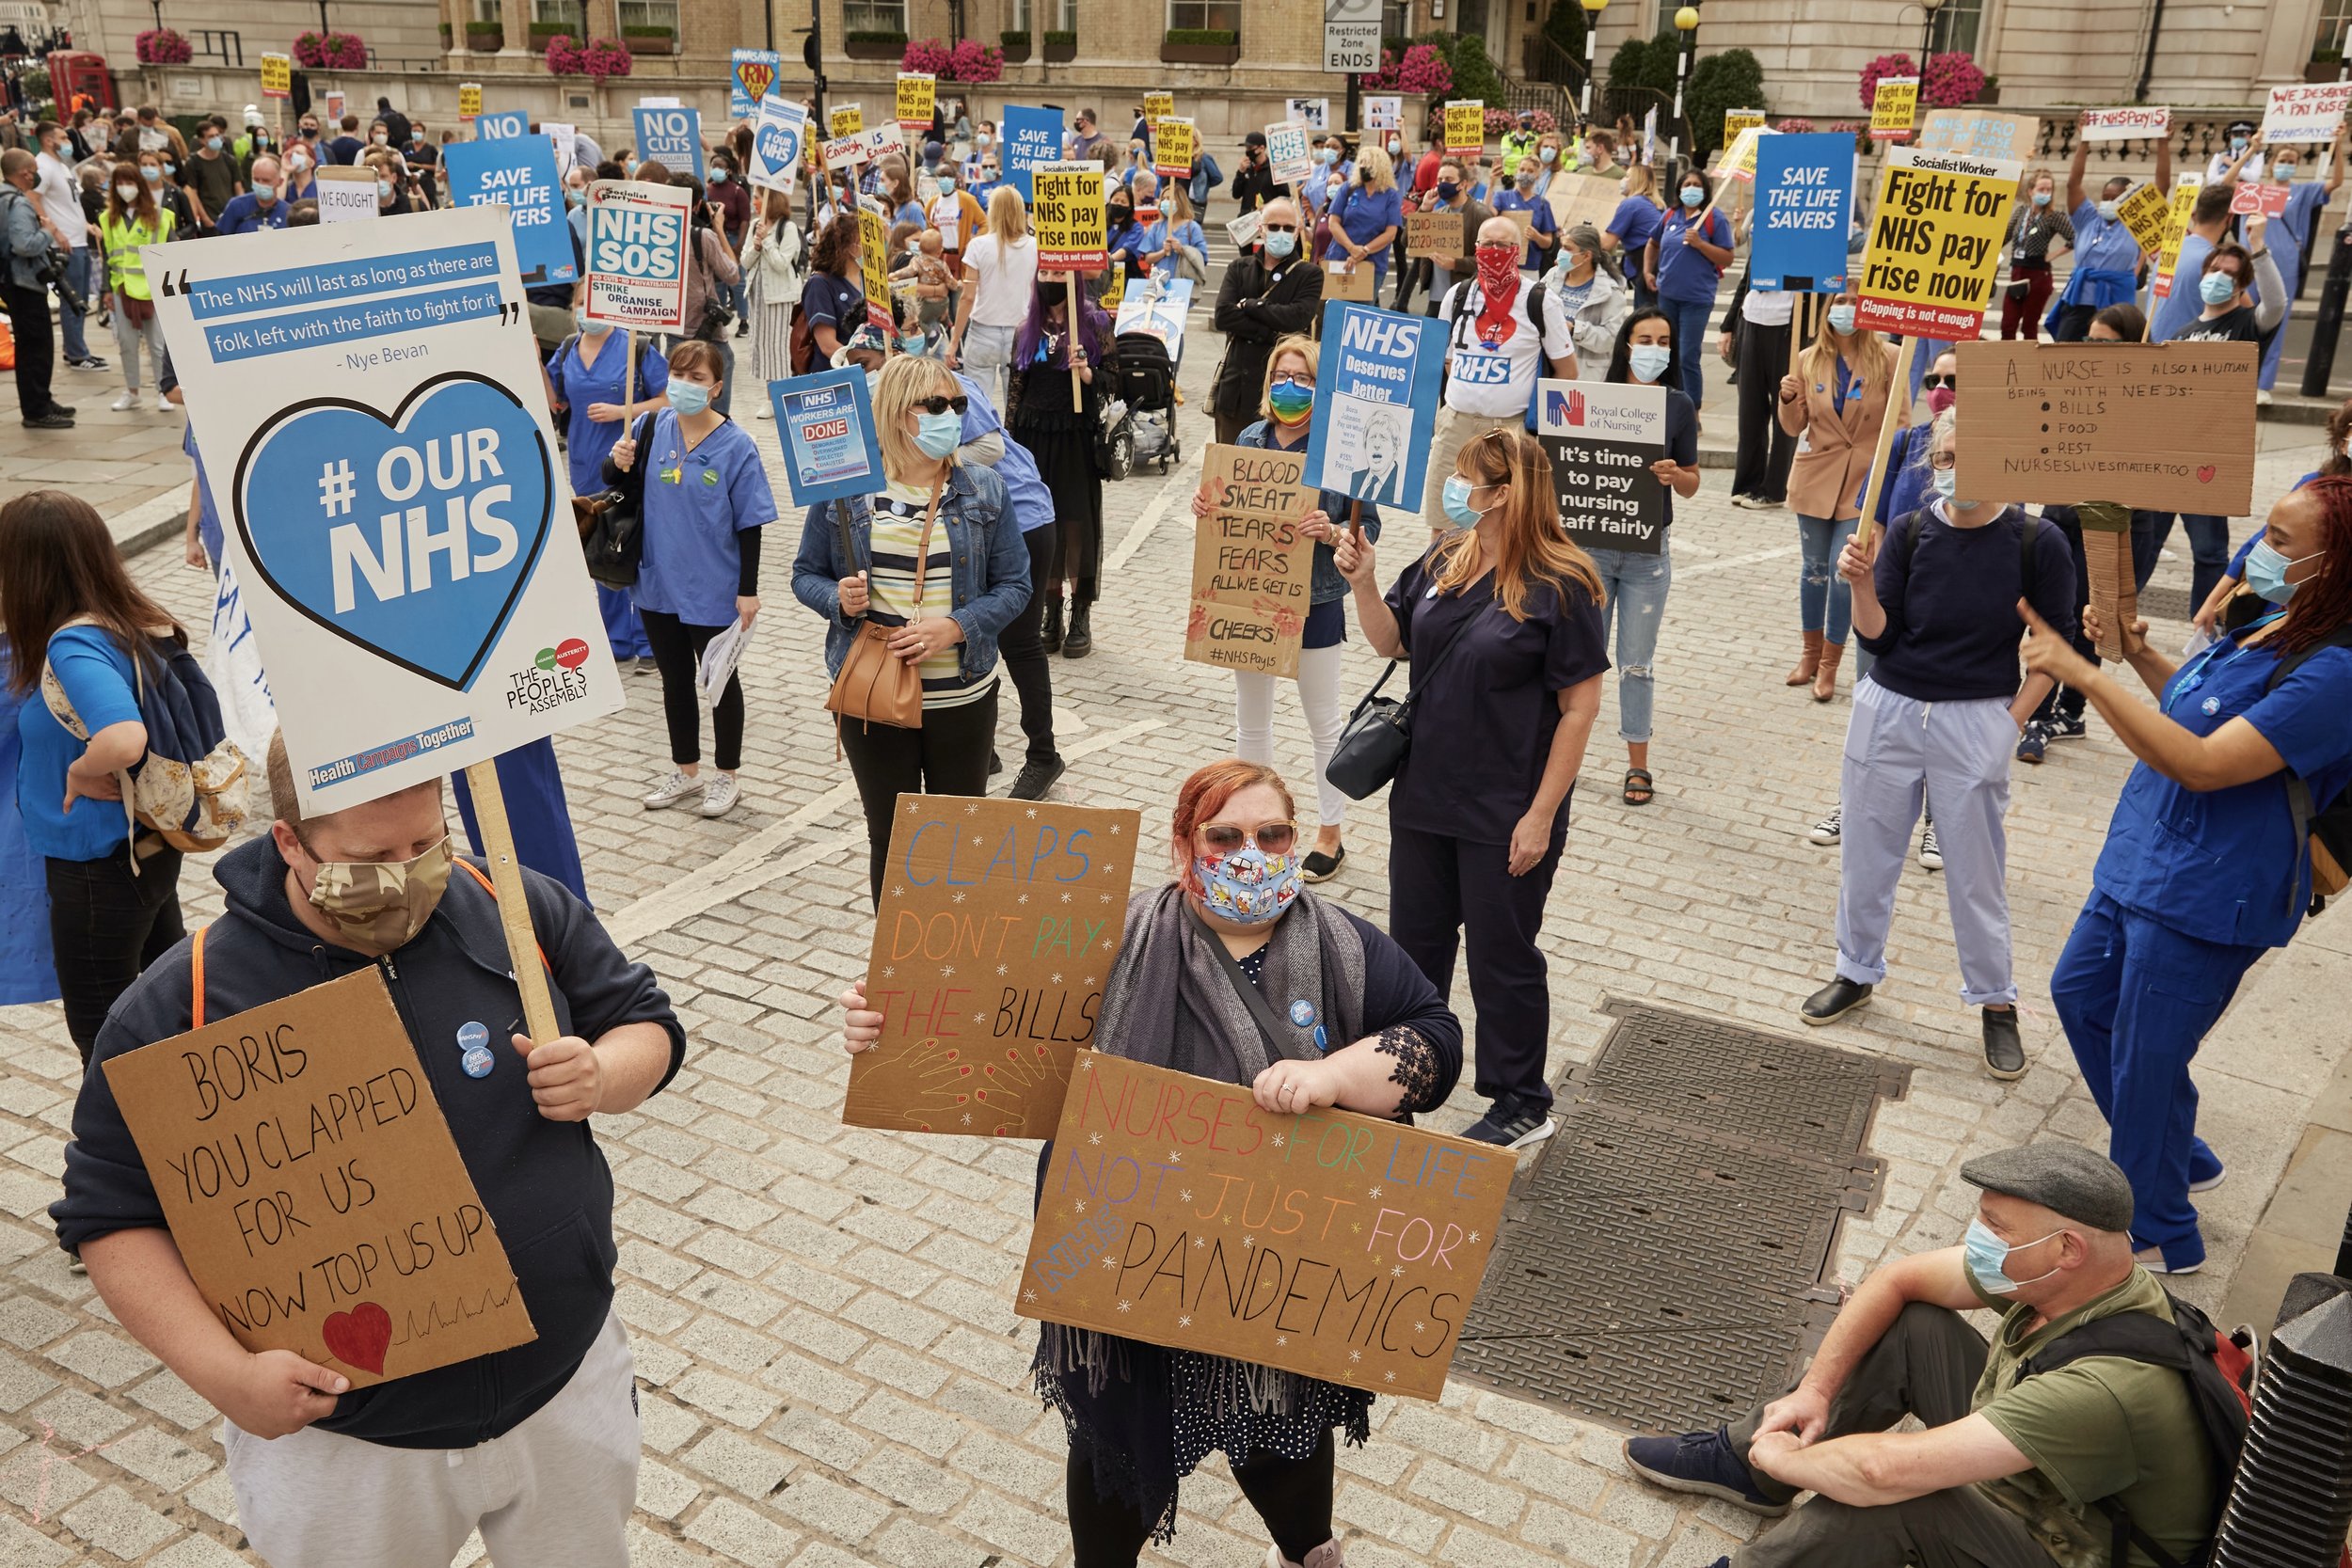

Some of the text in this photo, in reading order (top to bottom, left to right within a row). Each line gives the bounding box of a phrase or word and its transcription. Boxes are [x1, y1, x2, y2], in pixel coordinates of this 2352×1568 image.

[1328, 25, 1377, 36] Restricted
[1341, 39, 1363, 48] Zone
[1331, 54, 1373, 67] ENDS
[899, 80, 932, 93] Fight for
[1878, 86, 1915, 100] Fight for
[898, 94, 930, 107] NHS pay
[1875, 101, 1911, 115] NHS pay
[833, 114, 848, 127] Fight
[898, 105, 914, 117] rise
[1448, 107, 1480, 121] Fight for
[482, 116, 521, 140] NO
[643, 113, 689, 136] NO
[1158, 123, 1190, 137] Fight for
[1448, 121, 1479, 134] NHS pay
[647, 137, 691, 151] CUTS
[772, 135, 792, 147] OUR
[1019, 129, 1049, 144] SAVE
[1158, 139, 1188, 153] NHS pay
[1269, 132, 1302, 150] NHS
[1448, 134, 1462, 144] rise
[1010, 143, 1057, 159] THE LIFE
[1157, 150, 1189, 164] rise now
[1273, 144, 1305, 162] SOS
[1042, 165, 1068, 173] Socialist
[1781, 166, 1829, 185] SAVE
[1912, 155, 1997, 177] Socialist Worker
[480, 166, 532, 190] SAVE
[1035, 175, 1100, 200] Fight for
[320, 191, 374, 208] WE FOUGHT
[513, 186, 550, 206] LIFE
[1768, 189, 1842, 208] THE LIFE
[1885, 170, 2008, 218] Fight for
[1037, 202, 1098, 227] NHS pay
[1410, 218, 1430, 230] 2010
[1768, 211, 1836, 229] SAVERS
[597, 209, 677, 246] NHS
[1039, 229, 1102, 245] rise now
[1408, 235, 1431, 248] 2020
[1876, 215, 1991, 270] NHS pay
[596, 241, 675, 277] SOS
[1040, 252, 1063, 262] Clapping
[196, 253, 493, 308] The NHS will last as long as there are
[593, 282, 628, 294] STRIKE
[631, 279, 678, 289] PRIVATISATION
[1867, 257, 1984, 302] rise now
[608, 294, 662, 307] ORGANISE
[620, 306, 677, 316] CAMPAIGN
[1861, 299, 1905, 320] Clapping
[1906, 306, 1916, 319] is
[1918, 309, 1936, 323] not
[1938, 314, 1975, 329] enough
[214, 293, 497, 355] folk left with the faith to fight for it
[1343, 315, 1420, 358] NHS
[346, 341, 429, 372] Nye Bevan
[1345, 355, 1406, 382] Deserves
[1454, 356, 1509, 383] NHS
[2042, 360, 2187, 381] NURSE IS ALSO
[804, 391, 834, 406] NHS
[1351, 379, 1392, 403] Better
[2008, 384, 2194, 400] BEING WITH NEEDS:
[789, 404, 854, 424] WORKERS ARE
[1590, 405, 1658, 422] Royal College
[2059, 402, 2106, 415] BILLS
[805, 420, 846, 440] DONE
[1590, 419, 1642, 435] of Nursing
[2058, 423, 2097, 434] FOOD
[1559, 446, 1644, 467] It's time
[2058, 443, 2091, 454] REST
[377, 427, 504, 502] OUR
[1233, 458, 1299, 484] BLOOD
[1567, 470, 1633, 492] to pay
[1220, 484, 1296, 511] SWEAT
[1562, 494, 1639, 516] nursing
[1216, 515, 1295, 546] TEARS
[1600, 517, 1654, 540] fairly
[329, 484, 519, 614] NHS
[1219, 546, 1289, 574] FEARS
[1289, 582, 1303, 596] IS
[556, 645, 587, 659] AUSTERITY
[510, 667, 539, 689] THE
[530, 683, 587, 716] ASSEMBLY
[309, 720, 472, 786] Health Campaigns Together
[906, 820, 1093, 886] CLAPS
[1032, 914, 1105, 959] PAY
[873, 987, 1101, 1042] THE BILLS
[182, 1024, 308, 1121] BORIS
[166, 1068, 417, 1204] YOU CLAPPED
[1078, 1068, 1266, 1157] NURSES
[1285, 1114, 1375, 1173] FOR
[1385, 1137, 1489, 1200] LIFE
[233, 1158, 375, 1257] FOR US
[1062, 1148, 1464, 1270] NOT JUST FOR
[219, 1205, 484, 1333] NOW TOP US UP
[1116, 1222, 1460, 1358] PANDEMICS
